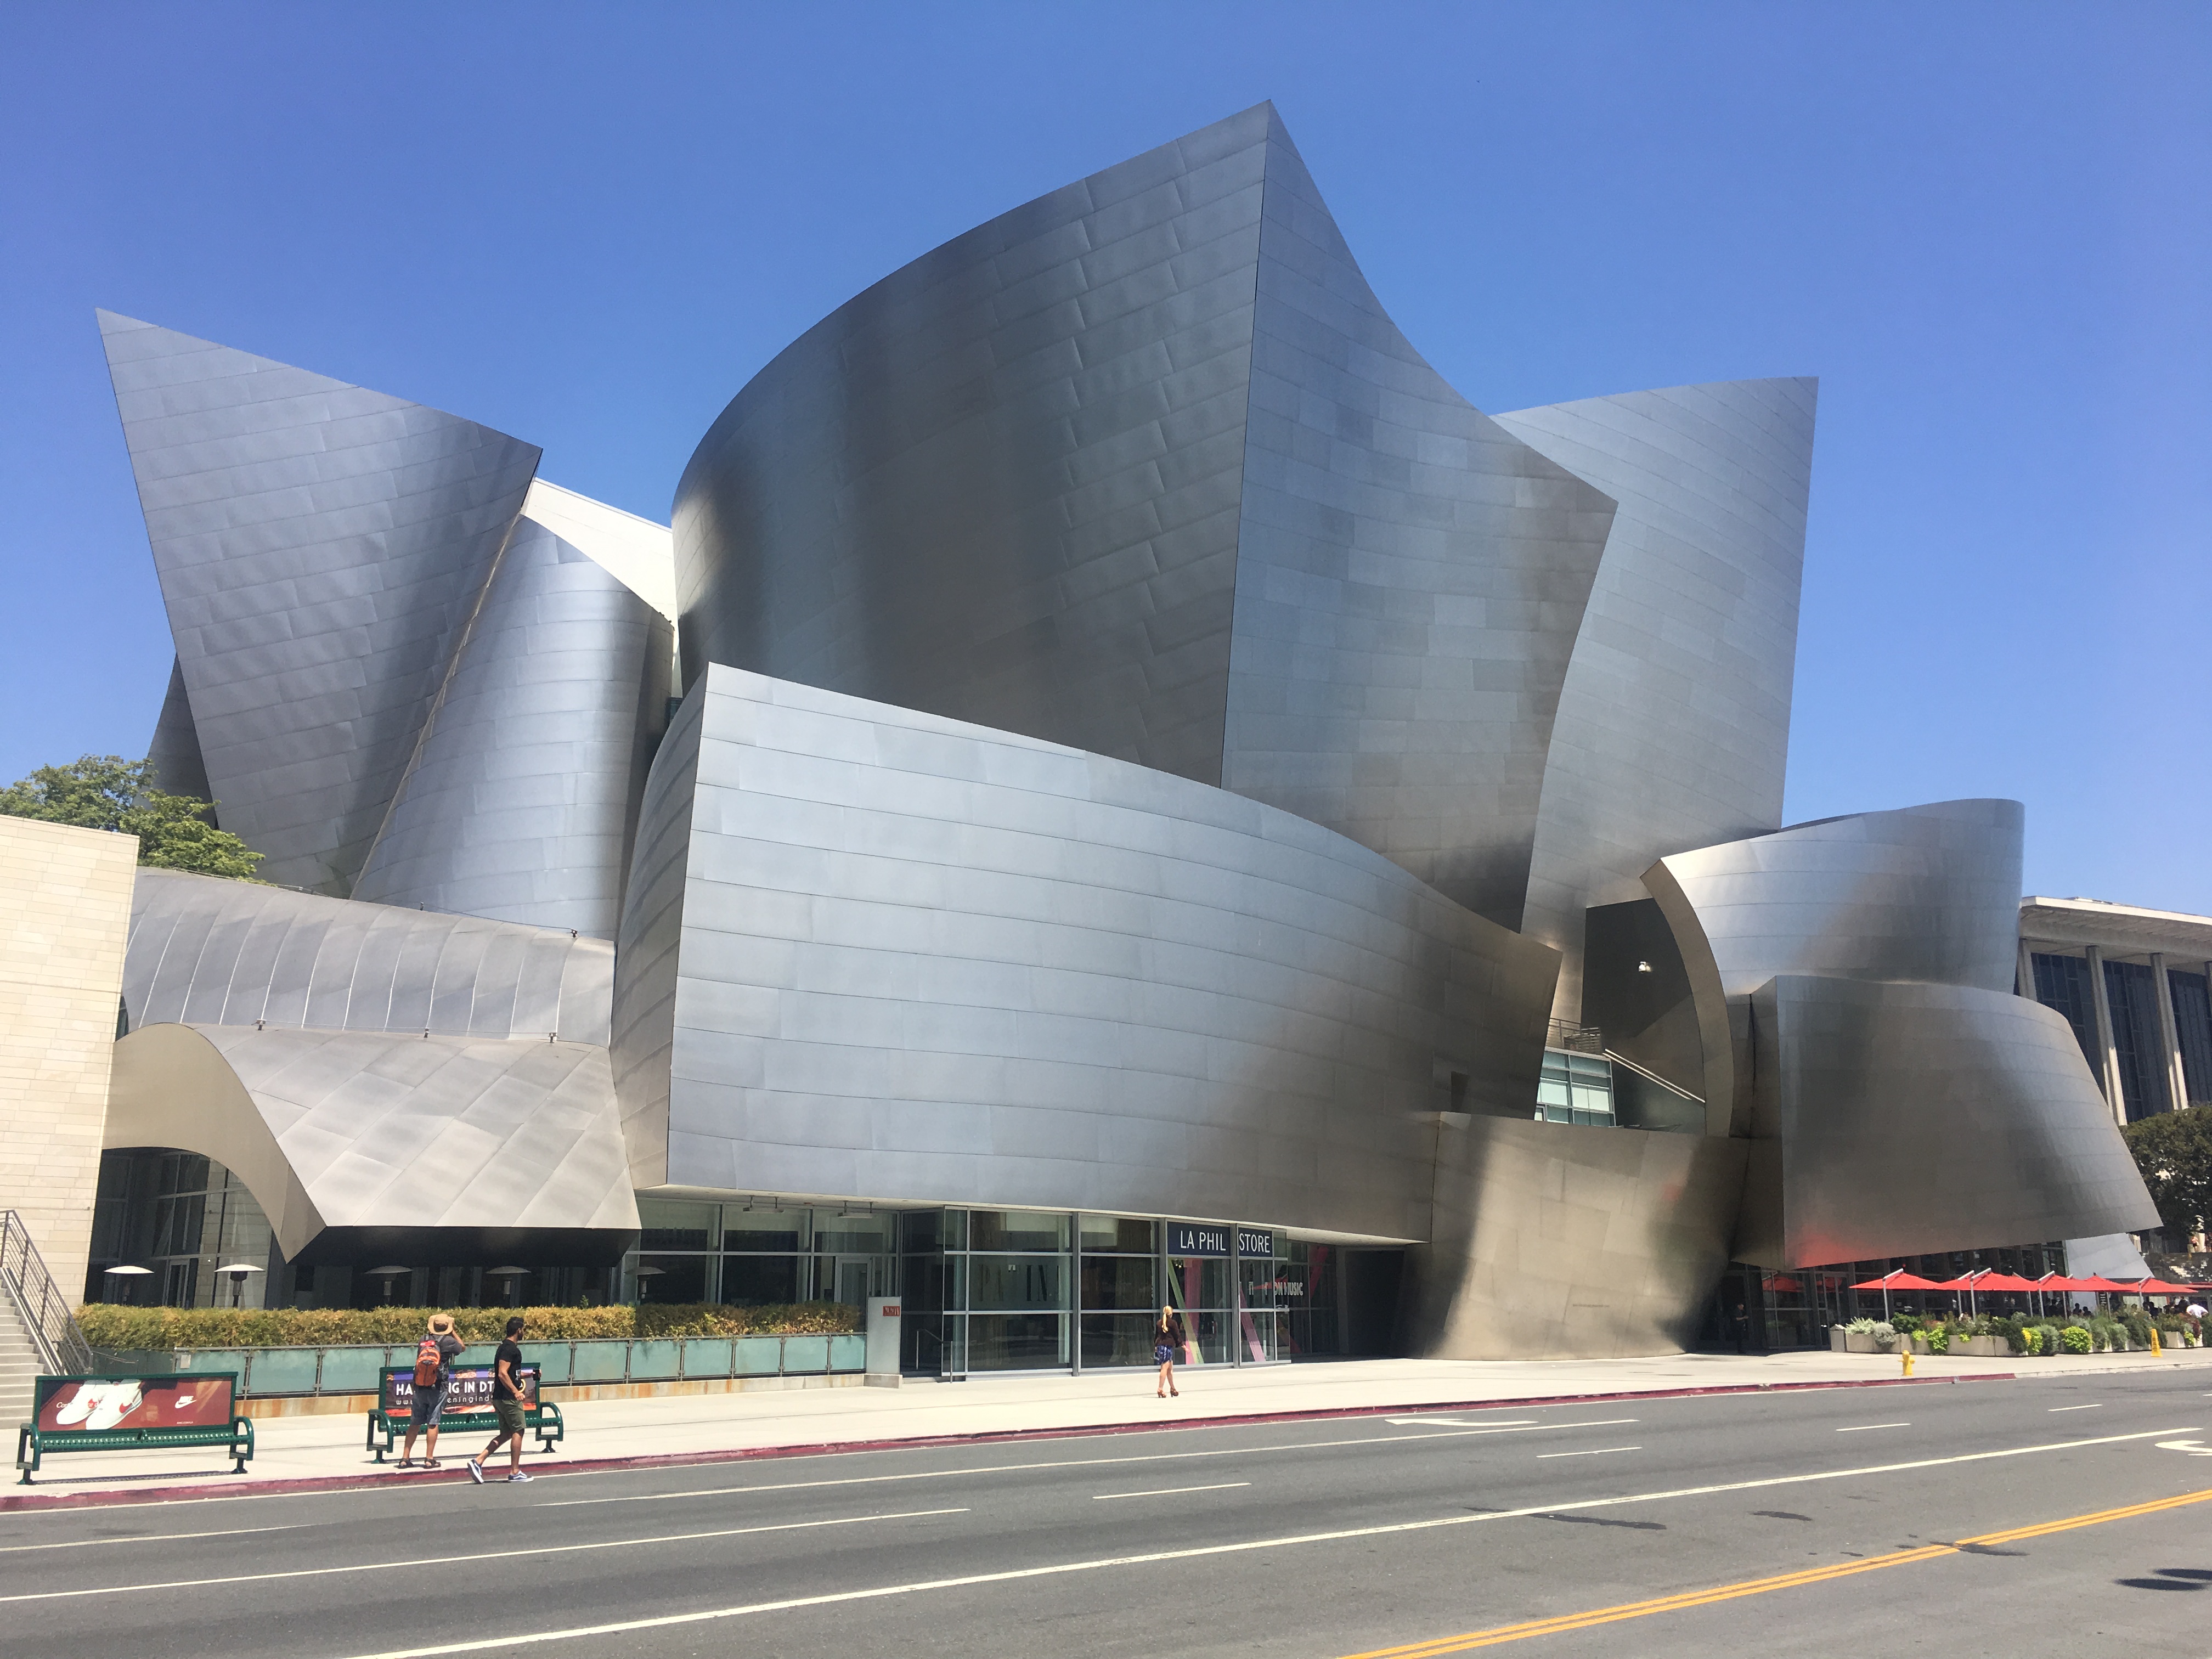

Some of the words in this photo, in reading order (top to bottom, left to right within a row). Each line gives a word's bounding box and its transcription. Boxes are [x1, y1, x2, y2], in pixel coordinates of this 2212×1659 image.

[1180, 1231, 1195, 1249] LA
[1199, 1232, 1226, 1251] PHIL
[1239, 1233, 1270, 1253] STORE
[978, 1264, 1063, 1302] PAINA
[1284, 1282, 1304, 1296] MUSIC
[464, 1381, 475, 1393] IN
